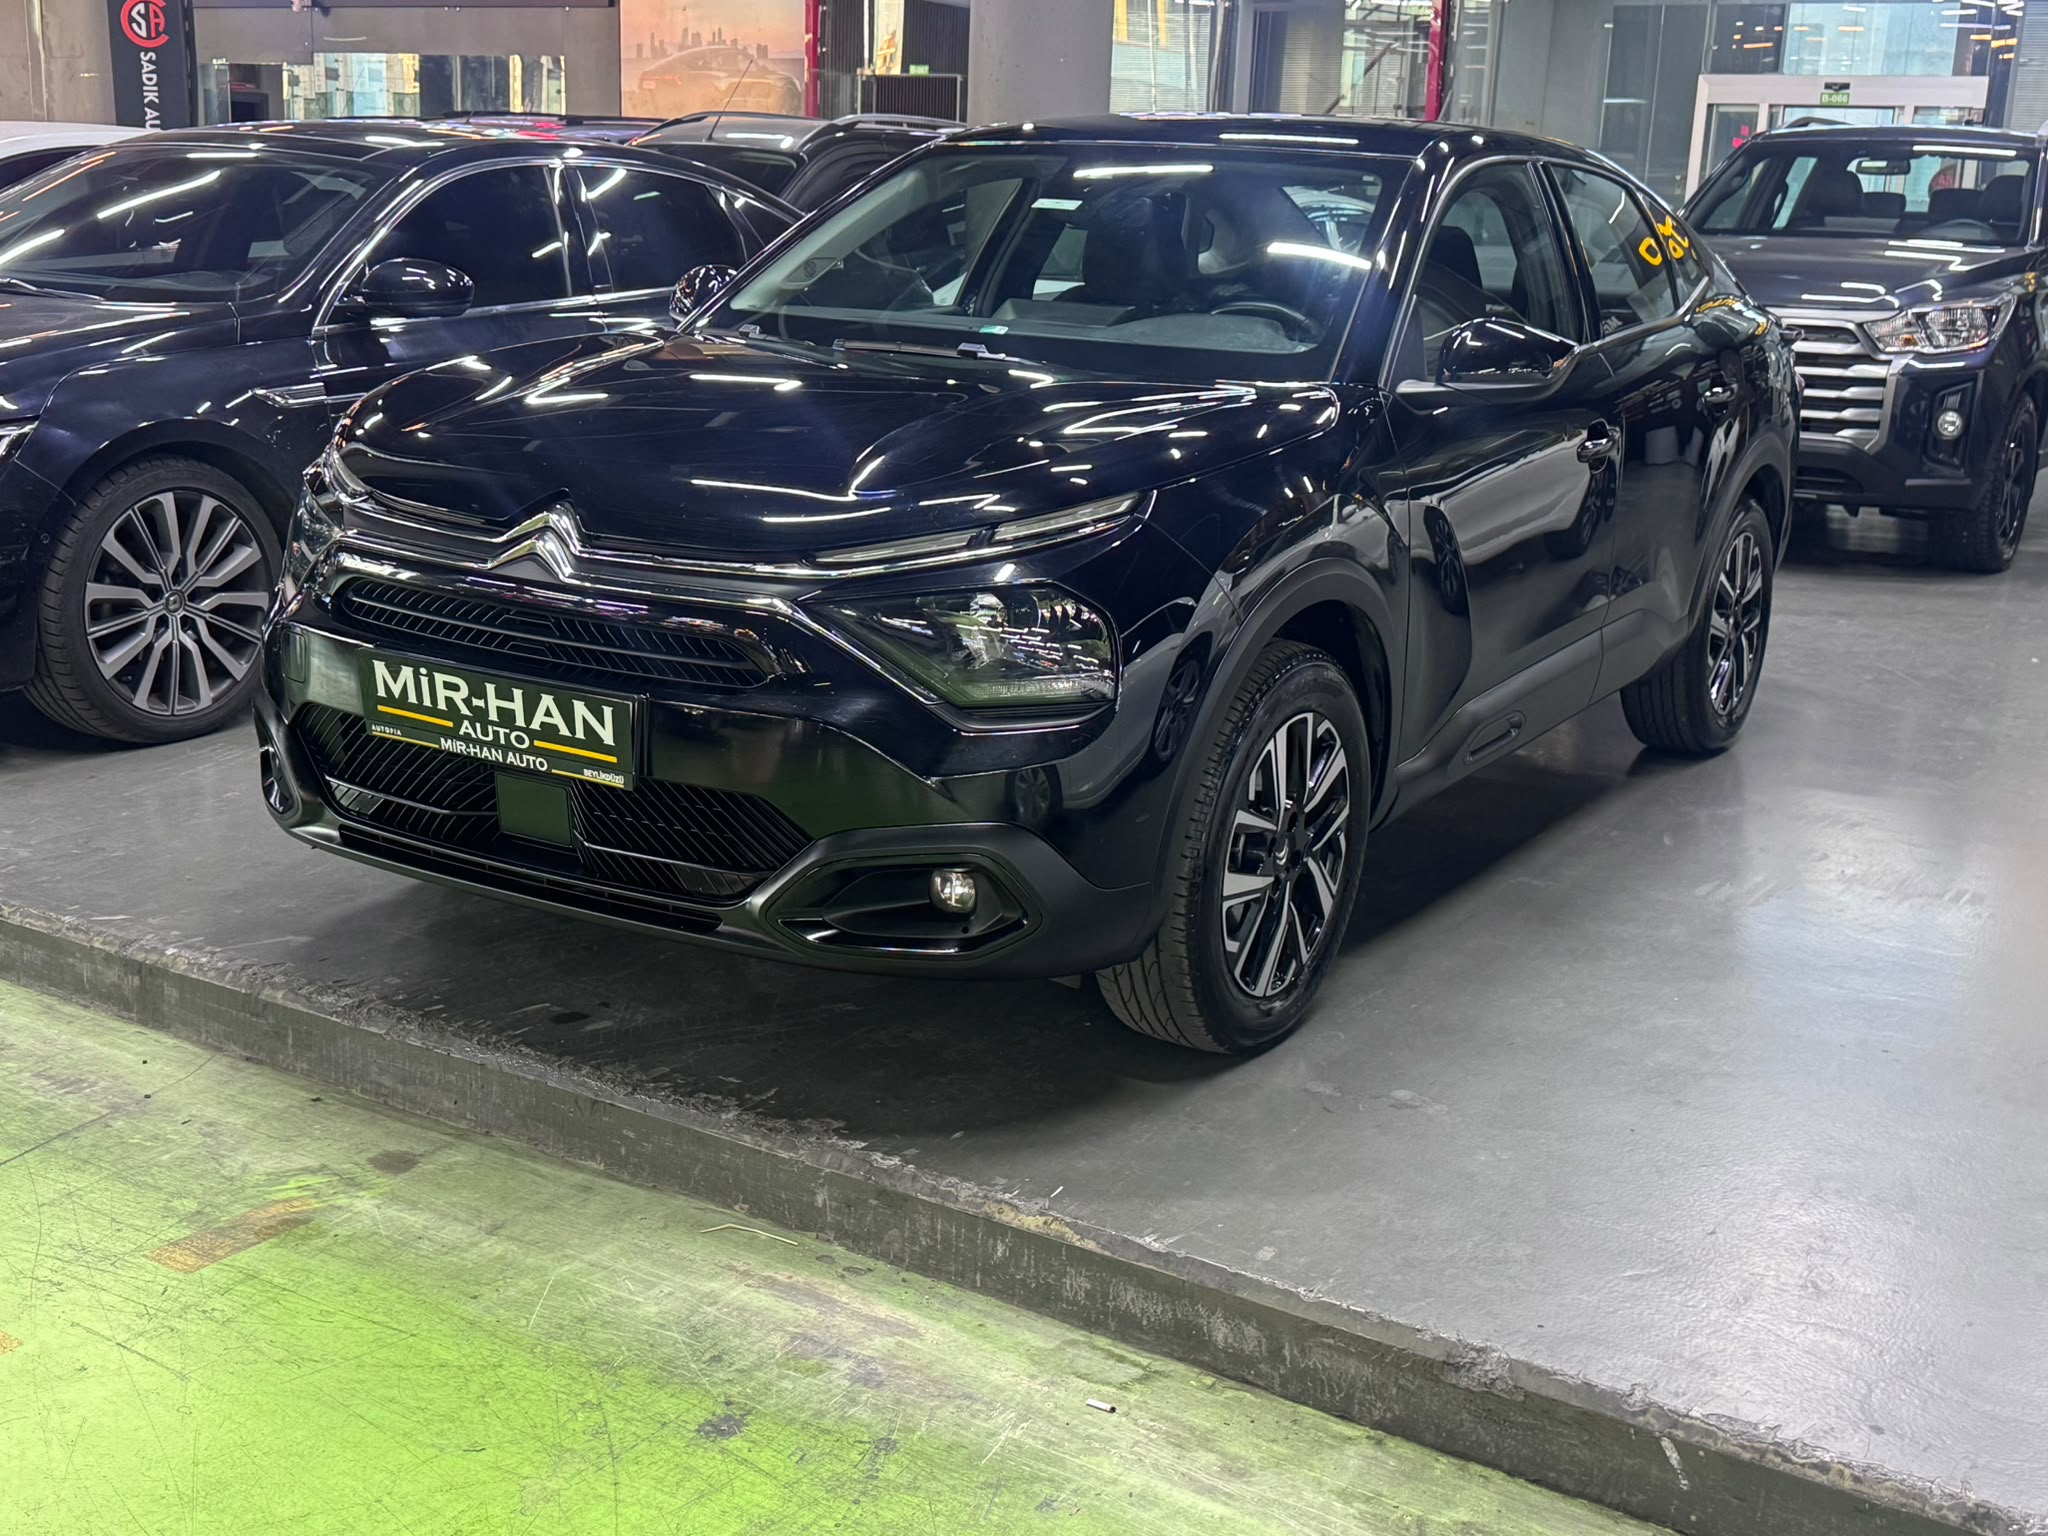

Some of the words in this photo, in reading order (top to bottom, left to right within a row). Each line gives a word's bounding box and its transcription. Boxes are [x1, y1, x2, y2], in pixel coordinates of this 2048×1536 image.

[140, 51, 159, 104] SADIK
[371, 724, 402, 736] AUTOPIA
[459, 720, 530, 749] AUTO
[506, 751, 548, 772] AUTO
